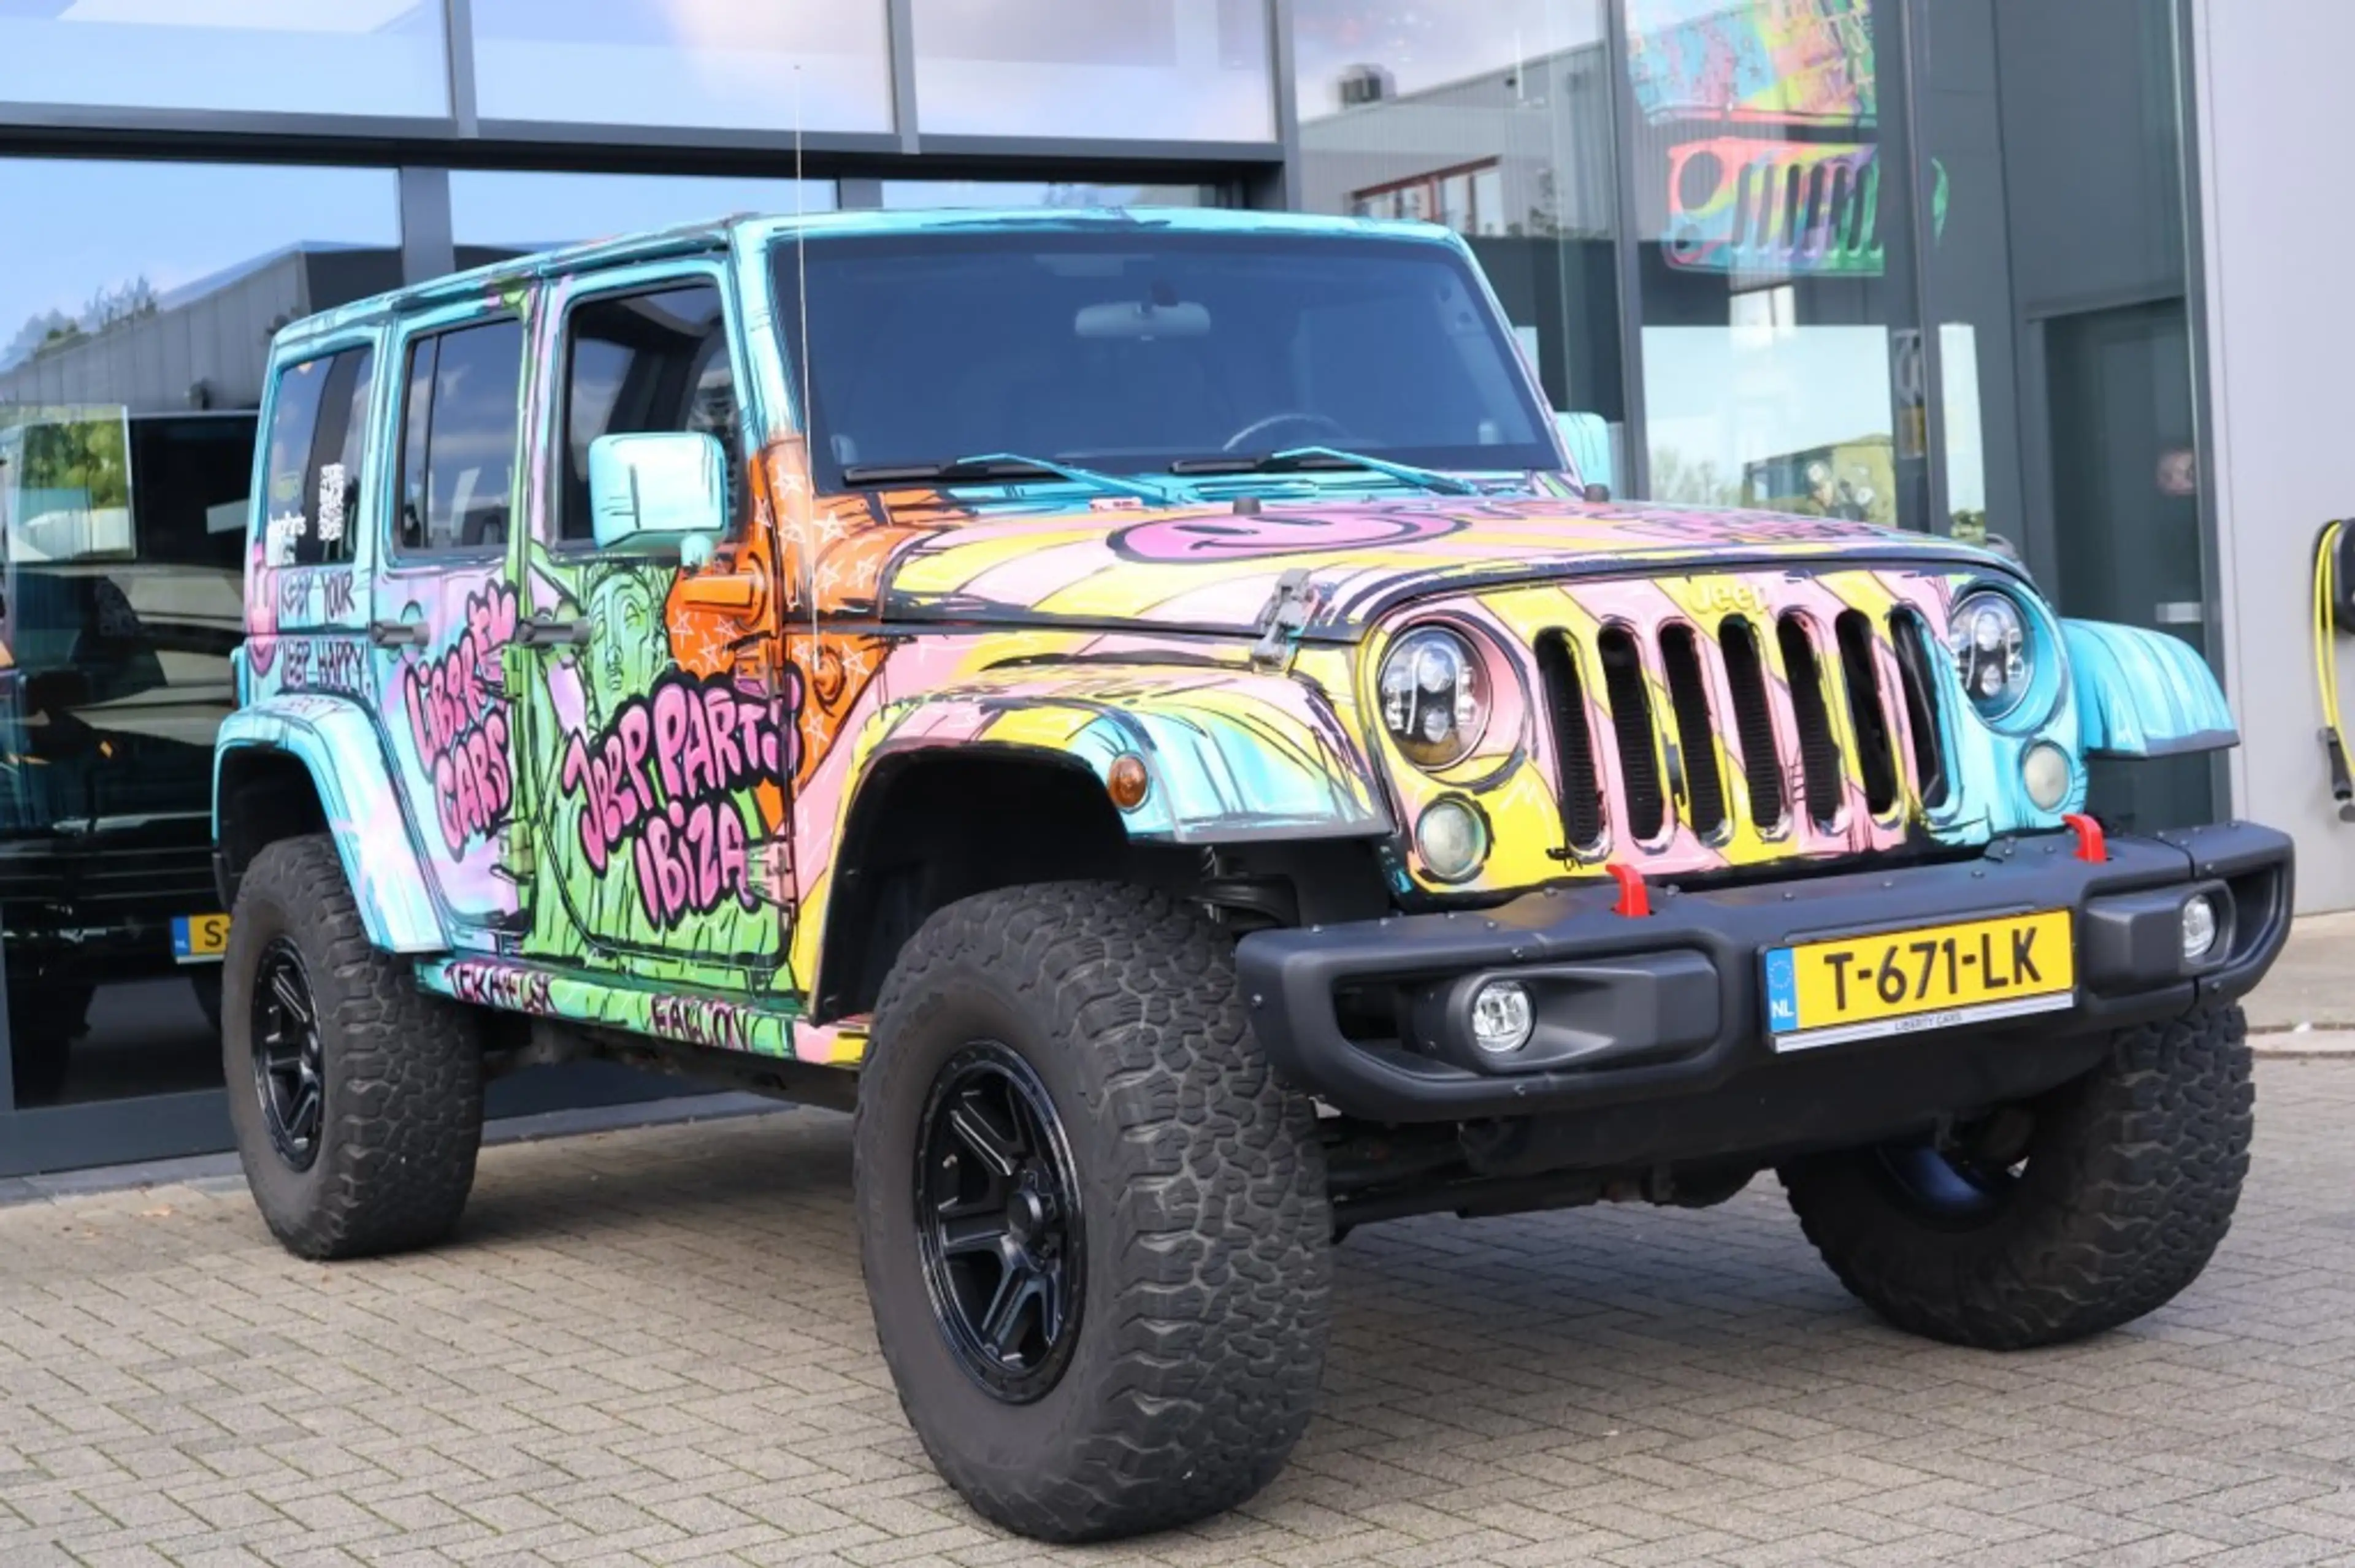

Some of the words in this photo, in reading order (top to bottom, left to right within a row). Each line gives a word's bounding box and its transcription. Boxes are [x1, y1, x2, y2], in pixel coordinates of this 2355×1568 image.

[319, 568, 356, 623] YOUR
[432, 706, 513, 863] CARS
[561, 692, 654, 879] JEEP
[1771, 1001, 1794, 1019] NL
[1823, 927, 2042, 1011] T-671-LK
